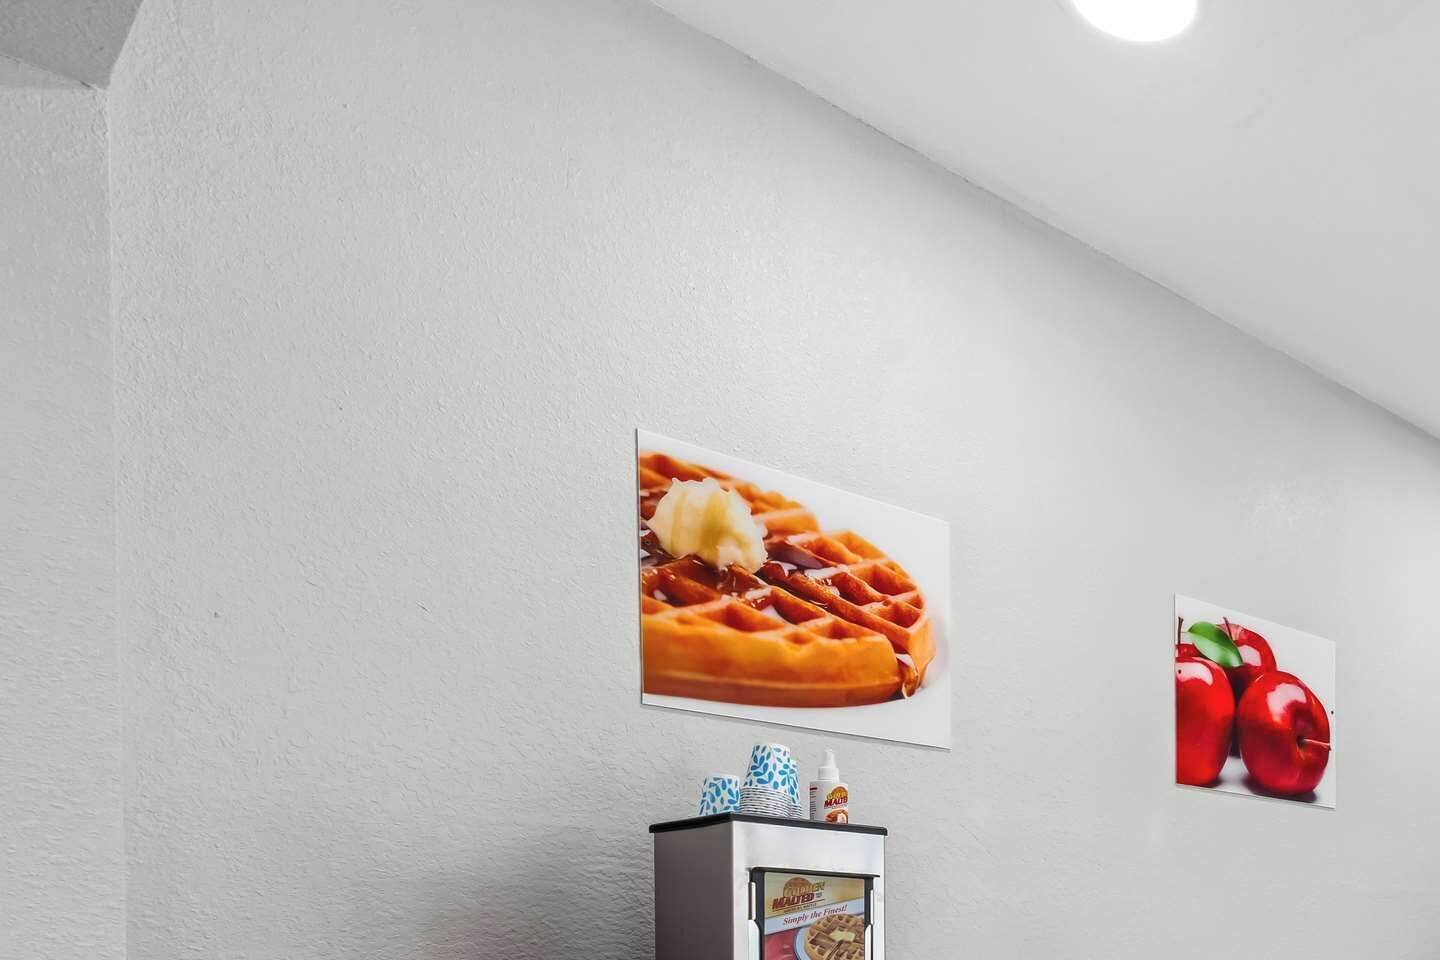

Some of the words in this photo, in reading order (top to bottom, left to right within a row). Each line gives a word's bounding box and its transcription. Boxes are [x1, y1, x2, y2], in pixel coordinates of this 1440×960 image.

[772, 892, 815, 911] MALTED
[783, 913, 809, 925] Simply
[810, 909, 823, 920] the
[823, 903, 849, 916] Finest!
